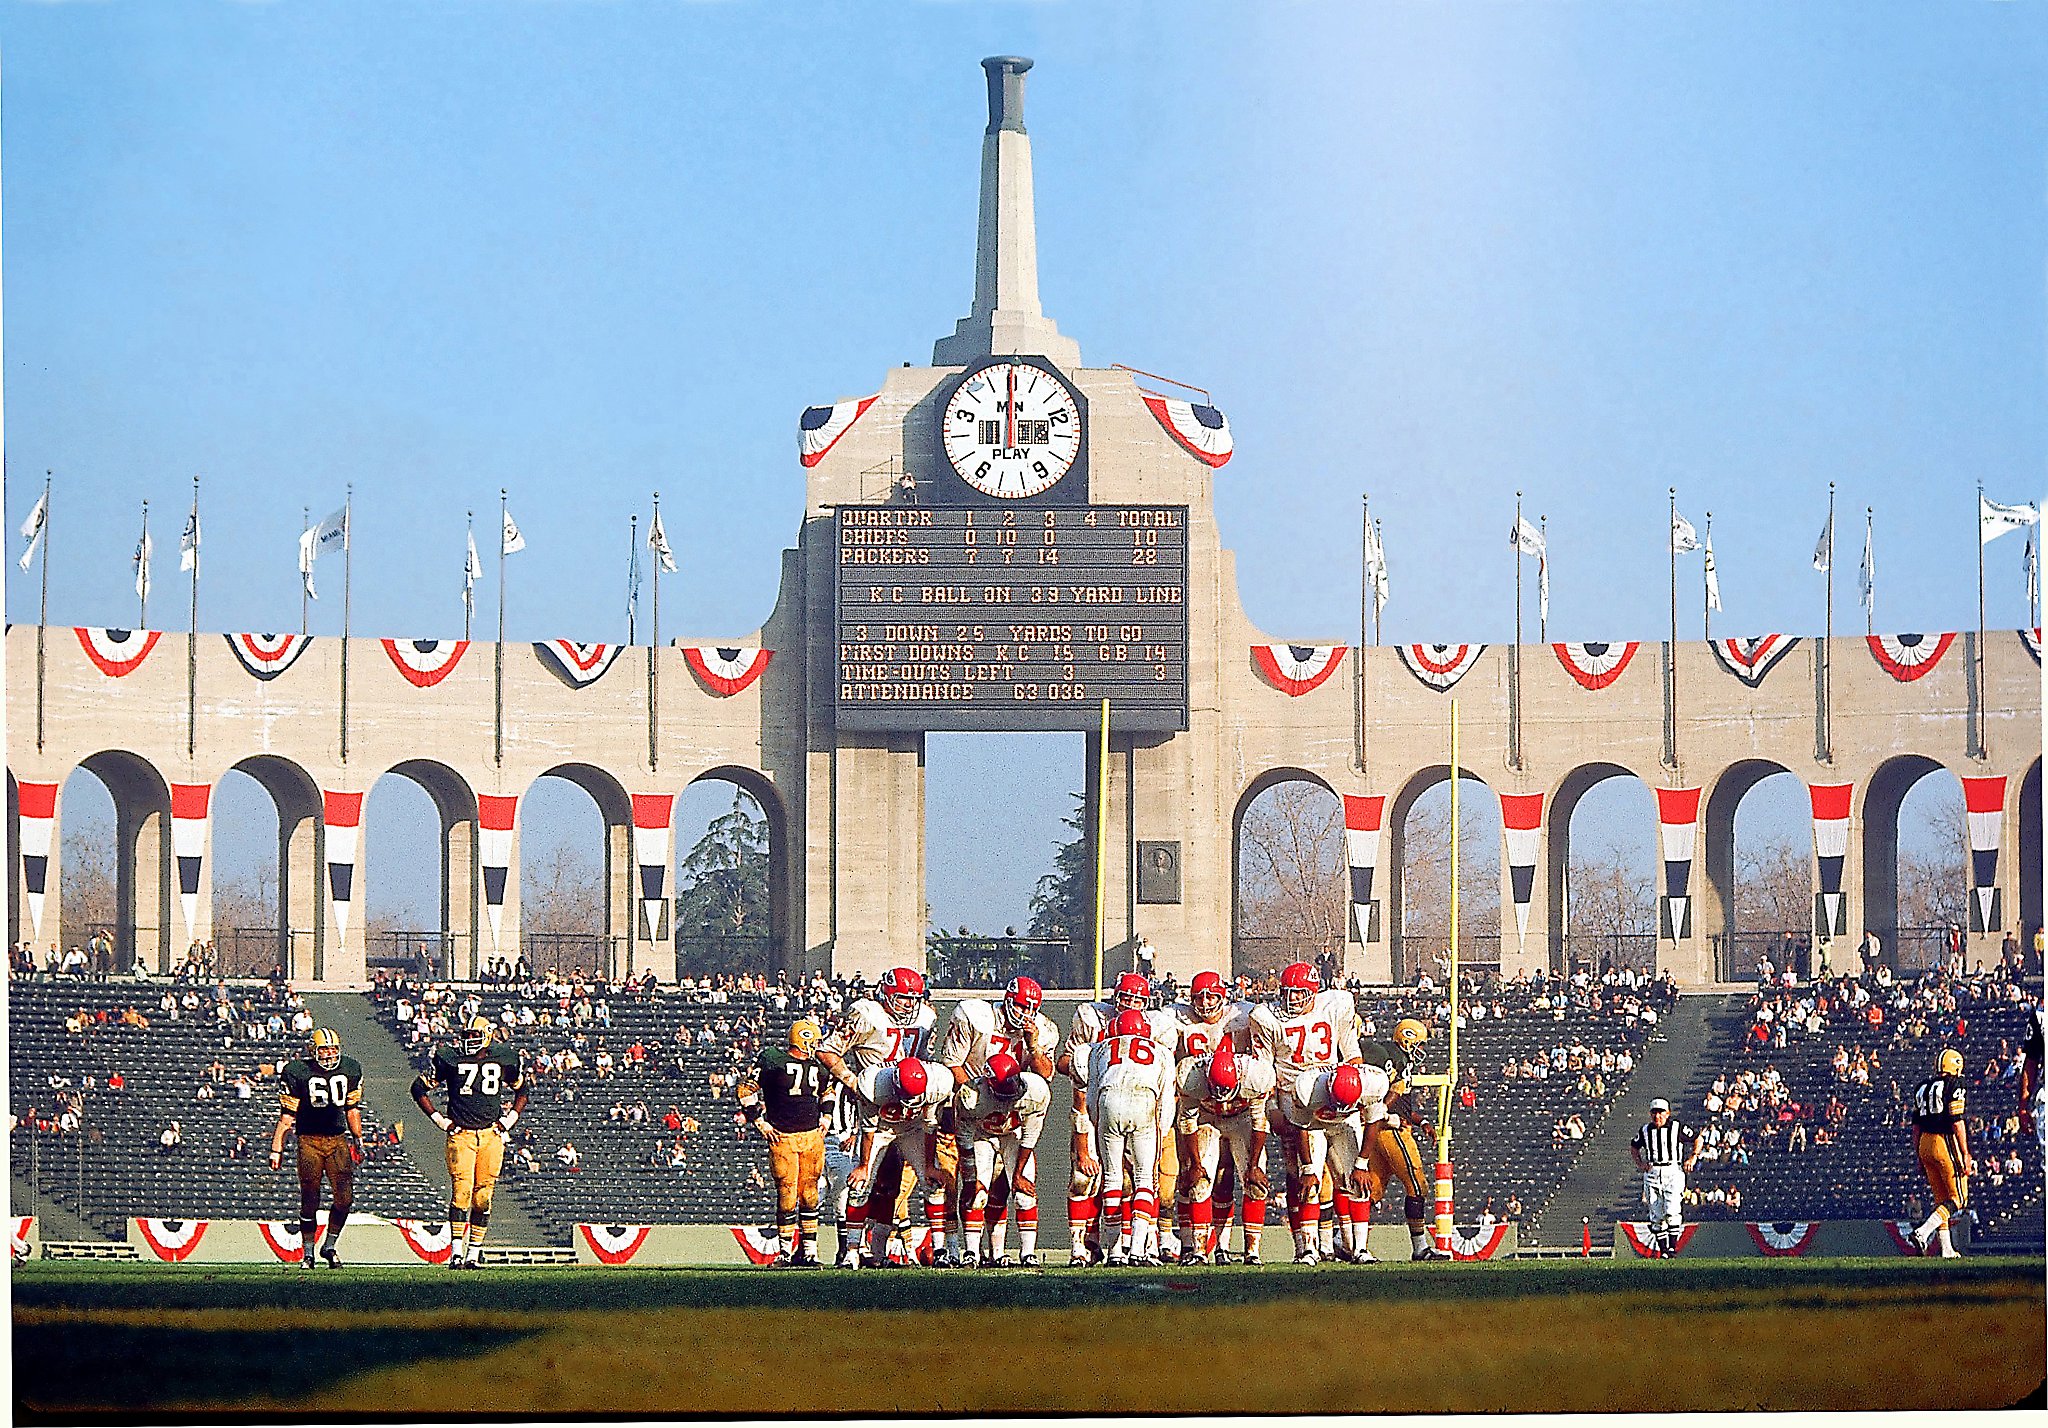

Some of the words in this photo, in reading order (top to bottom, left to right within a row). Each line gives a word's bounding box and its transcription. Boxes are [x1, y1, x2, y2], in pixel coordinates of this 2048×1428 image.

[997, 401, 1023, 413] MN
[957, 409, 975, 423] 3
[1048, 407, 1069, 427] 12
[992, 448, 1030, 460] PLAY
[975, 461, 991, 479] 6
[1032, 460, 1049, 479] 9
[842, 510, 932, 527] QUARTER
[1002, 510, 1015, 527] 2
[1044, 510, 1056, 527] 3
[1084, 510, 1097, 527] 4
[1117, 510, 1179, 527] TOTAL
[842, 529, 908, 546] CHIEFS
[965, 529, 977, 546] 0
[1044, 529, 1056, 546] 0
[1133, 529, 1158, 546] 10
[841, 548, 930, 564] PACKERS
[965, 548, 977, 564] 7
[1001, 548, 1014, 564] 7
[1038, 548, 1060, 564] 14
[1133, 548, 1158, 564] 28
[921, 587, 972, 603] BALL
[1070, 587, 1124, 603] YARD
[1135, 587, 1182, 603] LINE
[856, 625, 868, 642] 3
[885, 625, 939, 642] DOWN
[1009, 625, 1073, 642] YARDS
[1084, 625, 1108, 642] TO
[1120, 625, 1143, 642] GO
[841, 645, 896, 661] FIRST
[908, 645, 974, 661] DOWNS
[963, 664, 1015, 681] LEFT
[1063, 664, 1075, 681] 3
[1154, 664, 1167, 681] 3
[841, 684, 974, 700] ATTENDANCE
[884, 1028, 920, 1062] 77
[1107, 1037, 1156, 1065] 16
[1285, 1021, 1332, 1064] 73
[458, 1063, 501, 1095] 78
[308, 1075, 349, 1107] 60
[1915, 1080, 1945, 1116] 40
